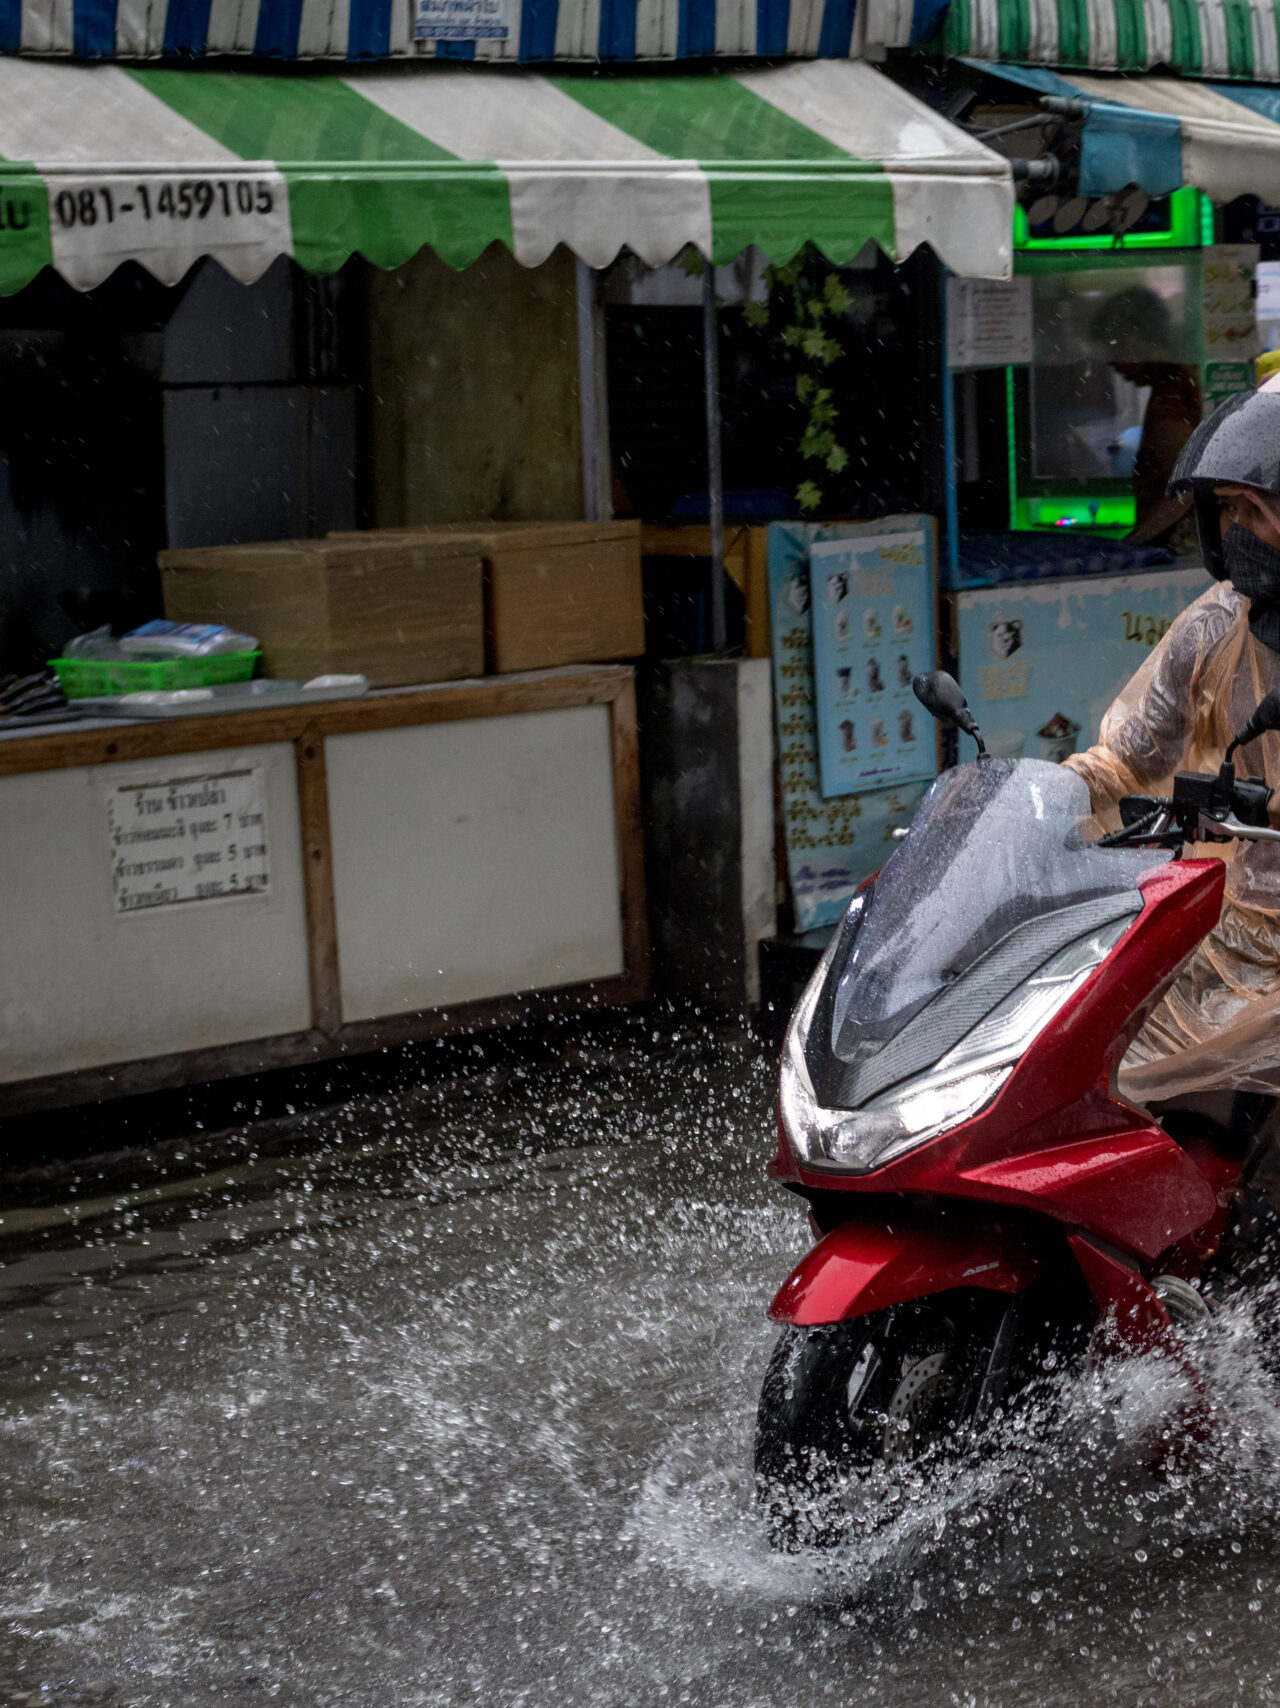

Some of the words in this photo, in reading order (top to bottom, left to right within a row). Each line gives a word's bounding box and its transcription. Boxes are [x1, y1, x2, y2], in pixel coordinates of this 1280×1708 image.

[54, 180, 274, 228] 081-1459105
[134, 790, 162, 816] ร้าน
[223, 812, 233, 830] 7
[228, 843, 238, 862] 5
[229, 873, 239, 891] 5
[962, 1261, 1000, 1277] ABS
